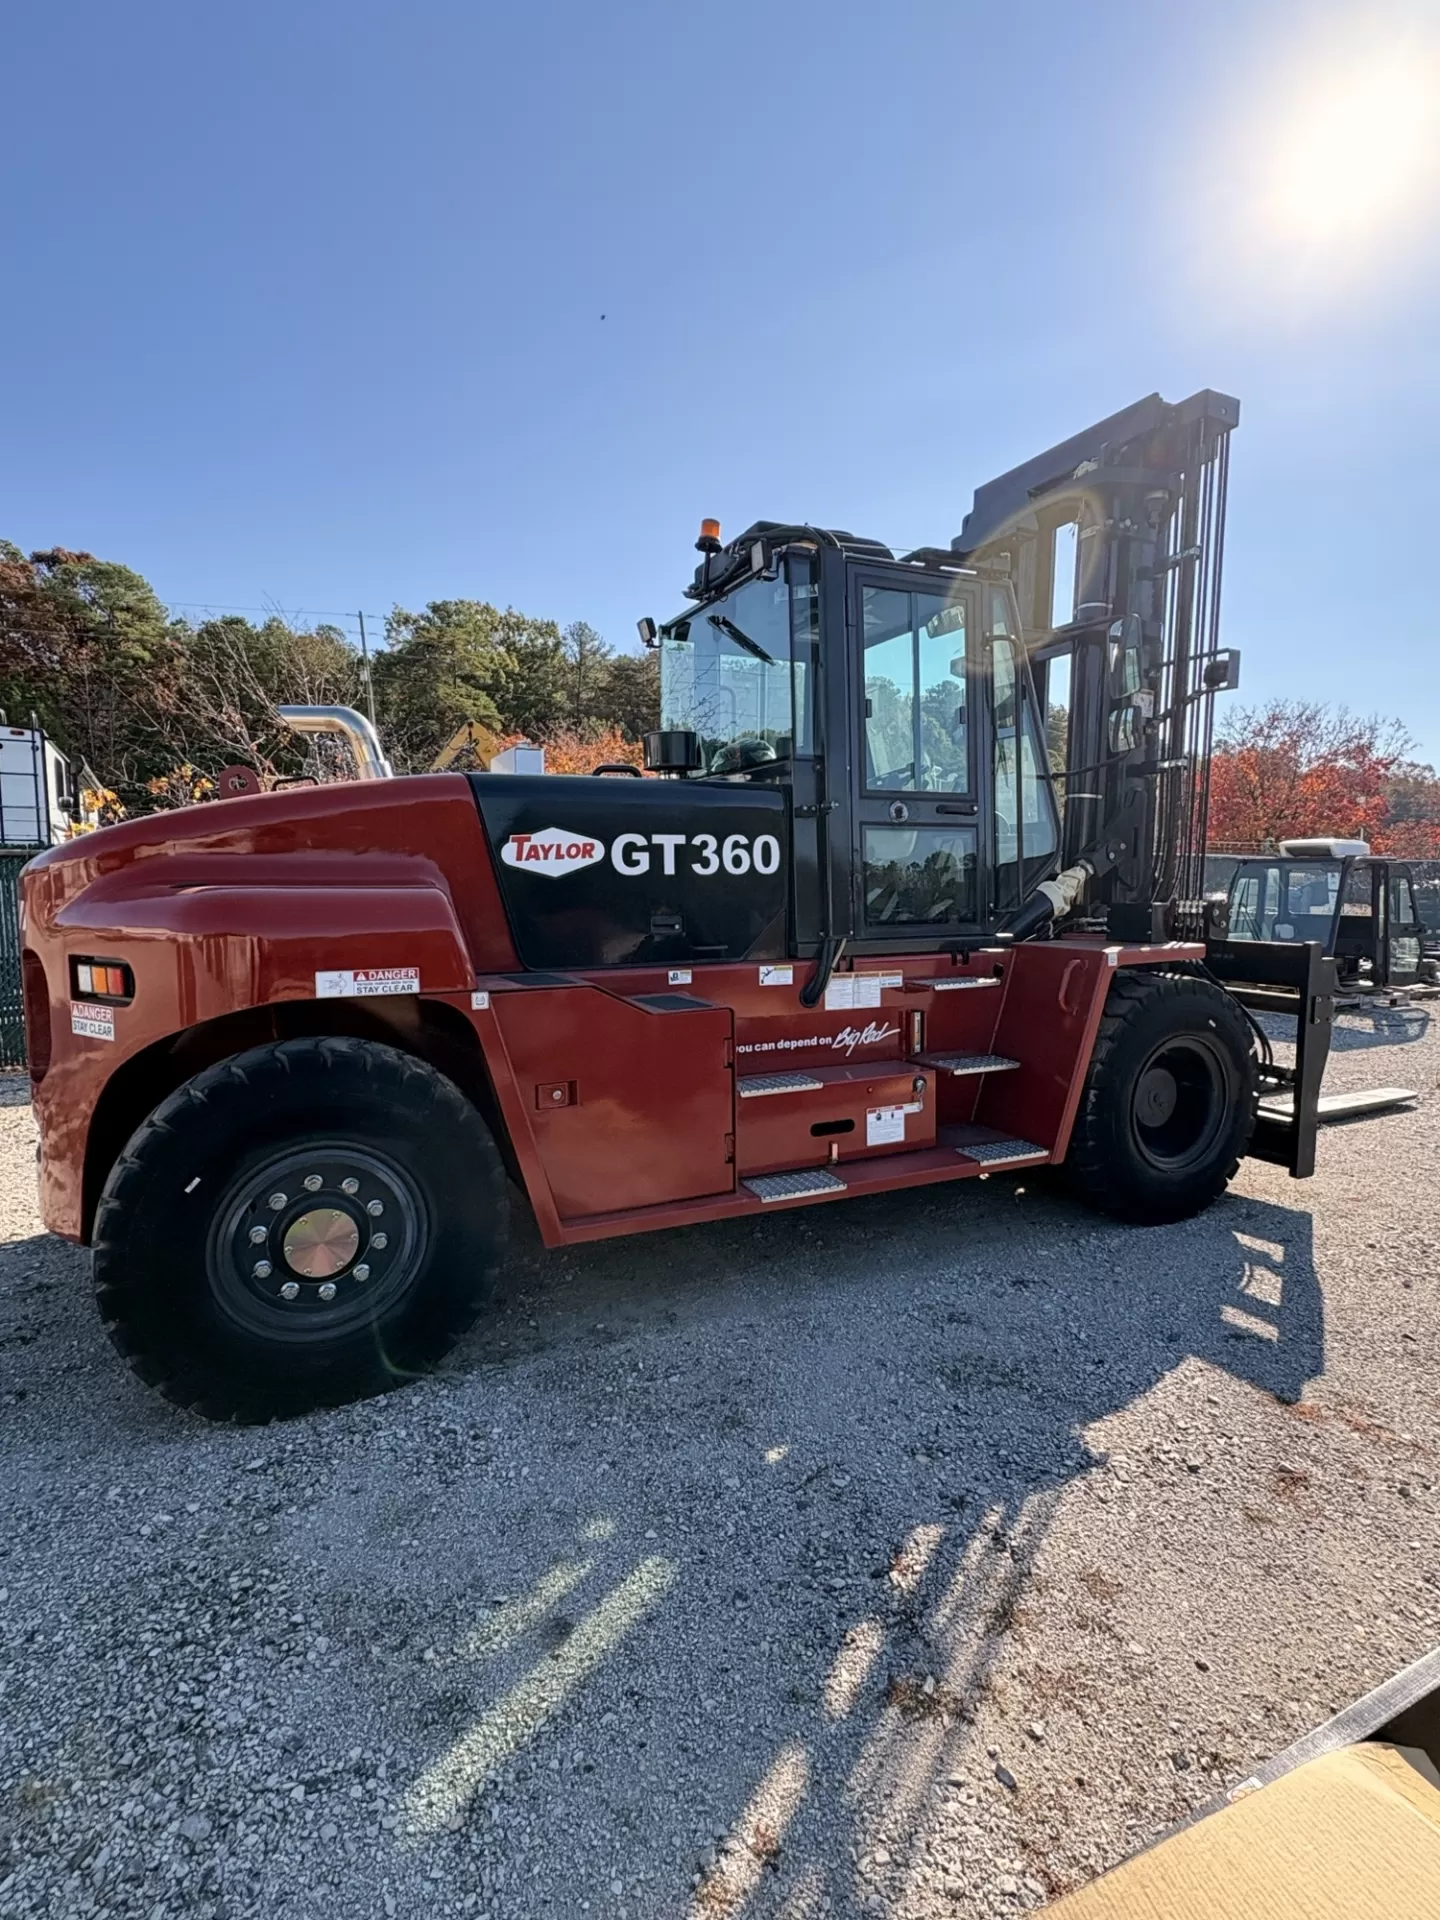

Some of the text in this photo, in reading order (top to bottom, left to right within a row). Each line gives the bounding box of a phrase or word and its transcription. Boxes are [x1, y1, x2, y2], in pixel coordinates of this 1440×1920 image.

[511, 834, 596, 862] TAYLOR
[369, 970, 416, 980] DANGER
[356, 984, 413, 995] STAY CLEAR
[78, 1004, 112, 1022] DANGER
[73, 1020, 112, 1036] STAY CLEAR
[754, 1041, 775, 1052] can
[777, 1036, 818, 1050] depend
[818, 1036, 832, 1045] on
[831, 1026, 861, 1057] Big
[858, 1021, 901, 1045] Red
